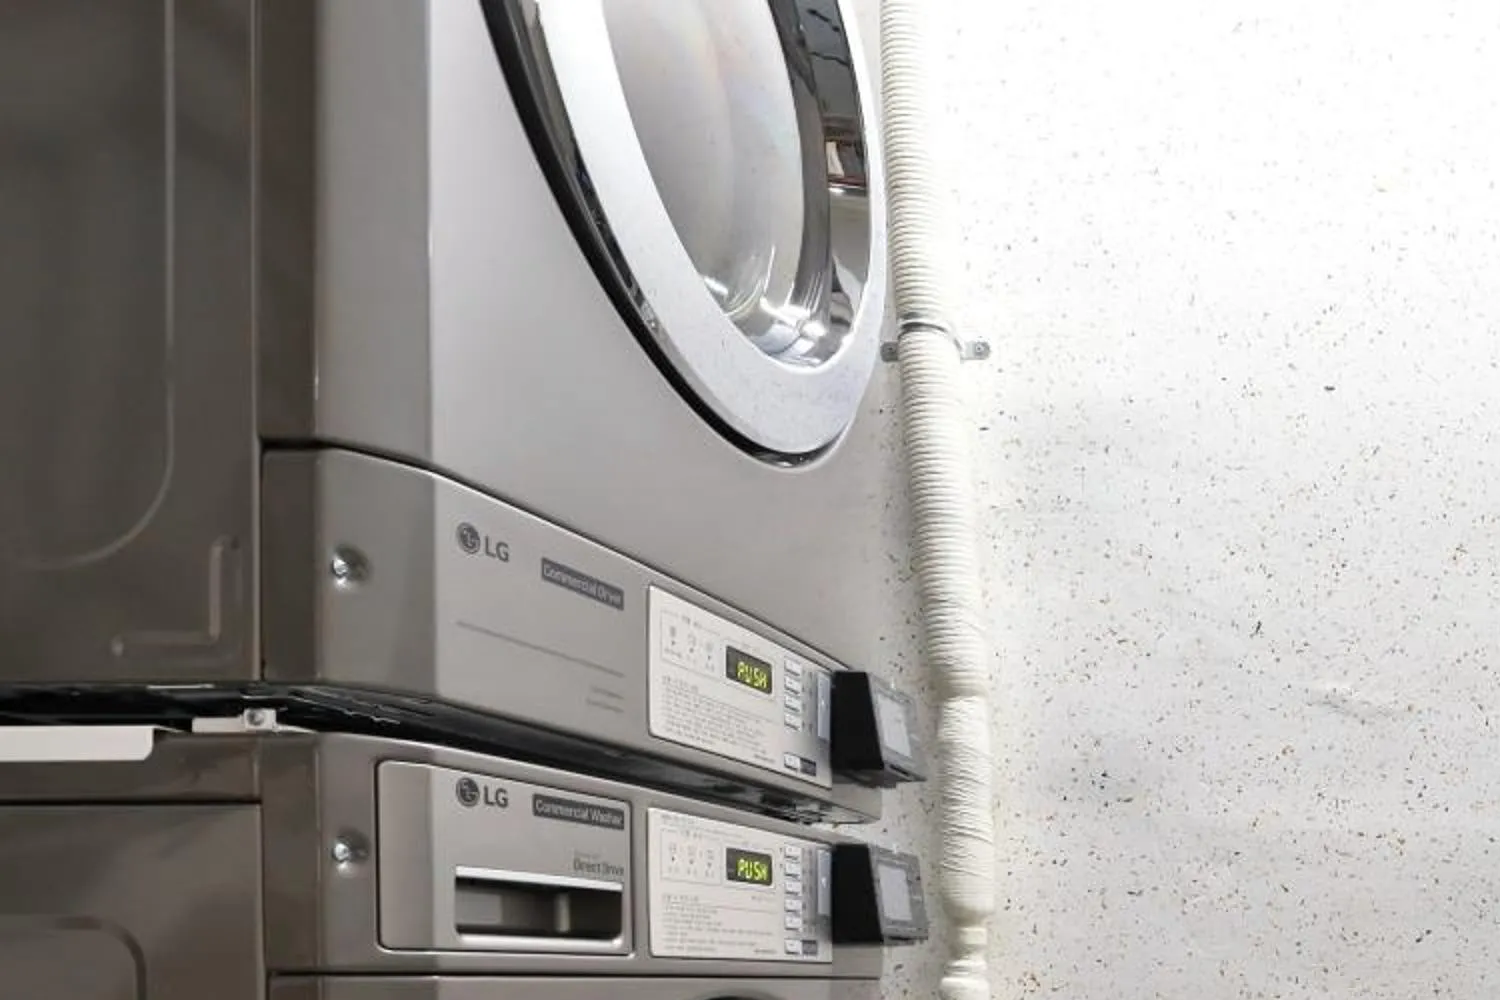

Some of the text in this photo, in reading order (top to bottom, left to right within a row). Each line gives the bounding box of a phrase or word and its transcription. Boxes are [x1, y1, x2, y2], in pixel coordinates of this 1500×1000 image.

[484, 536, 510, 562] LG
[737, 660, 768, 690] PUSH
[483, 784, 509, 809] LG
[535, 800, 588, 820] Commercial
[737, 858, 769, 882] PUSH
